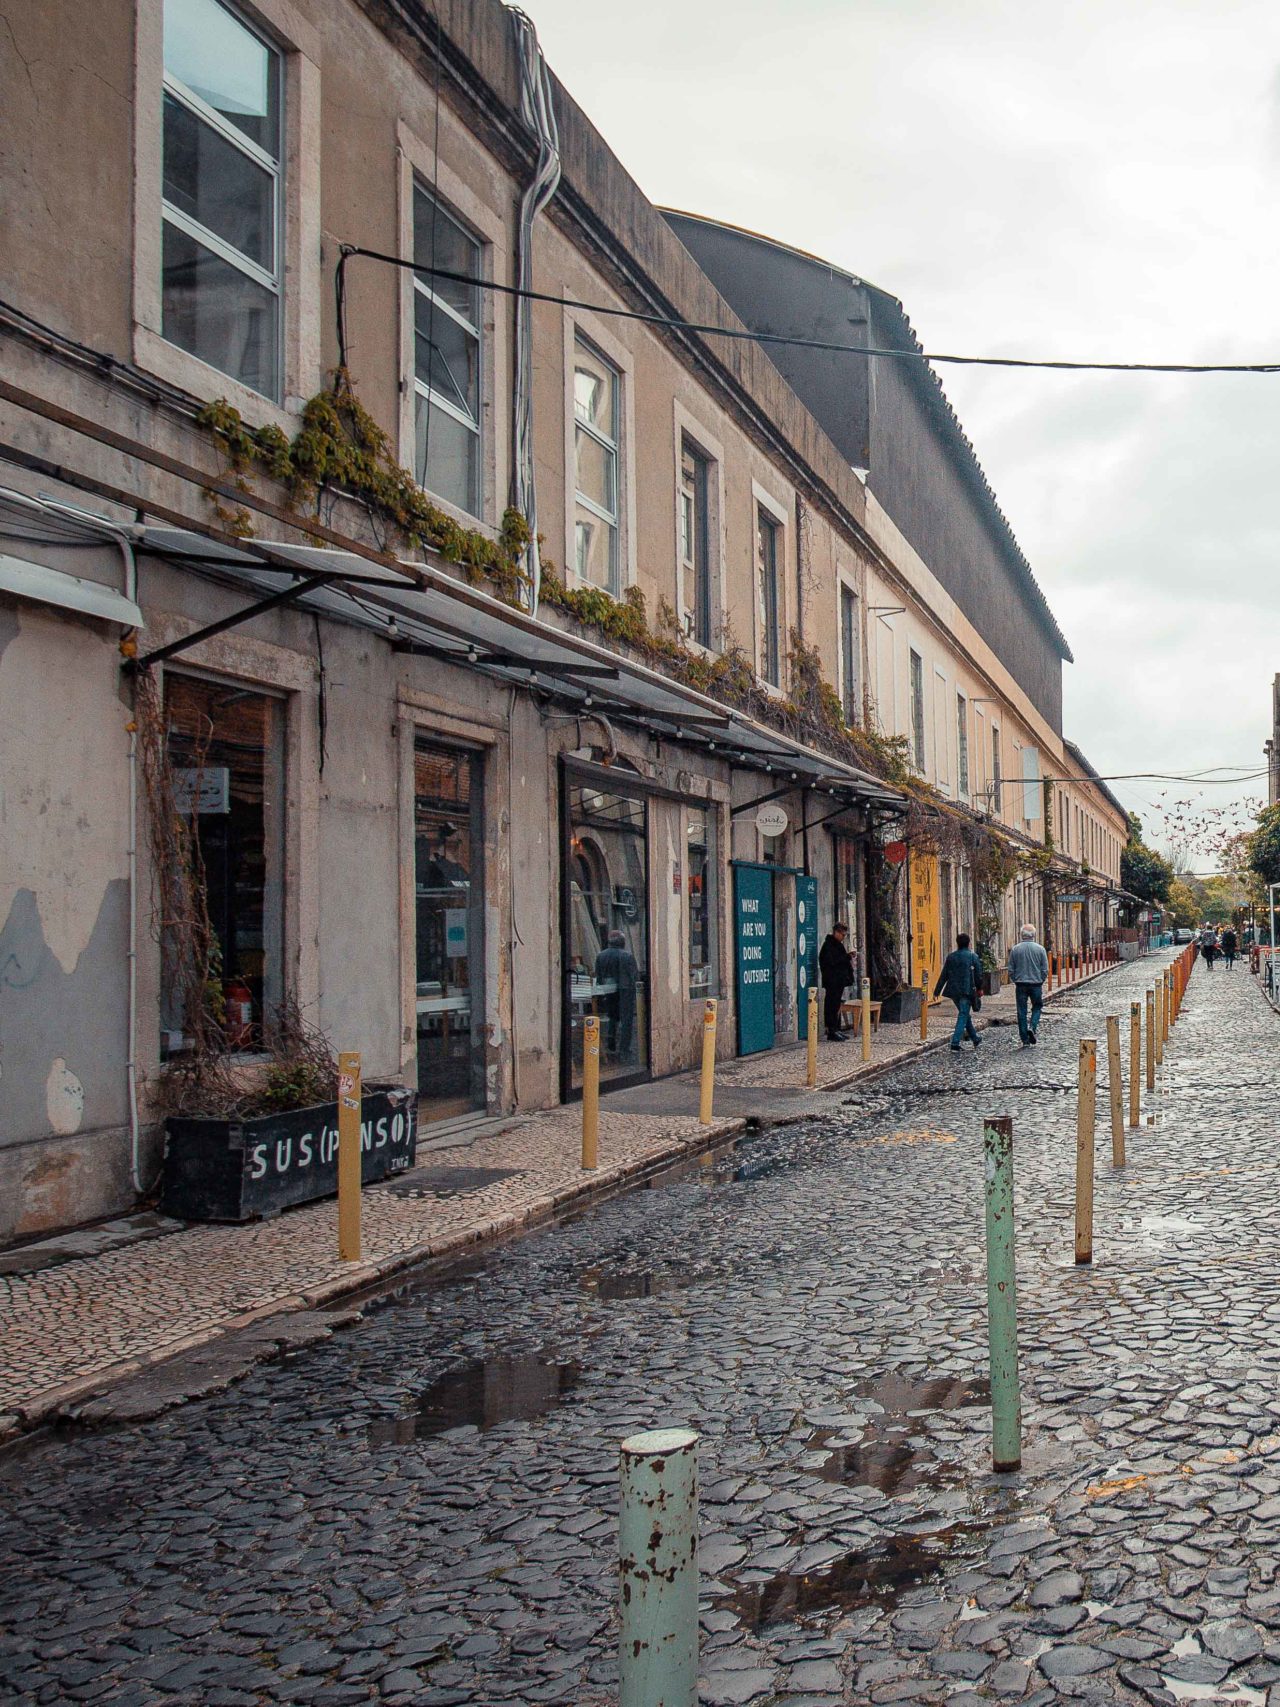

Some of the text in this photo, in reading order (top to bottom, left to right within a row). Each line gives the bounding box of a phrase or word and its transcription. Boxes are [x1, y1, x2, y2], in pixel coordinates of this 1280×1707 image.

[742, 899, 759, 912] WHAT
[743, 923, 766, 936] ARE YOU
[743, 947, 762, 960] DOING
[744, 969, 770, 984] OUTSIDE?
